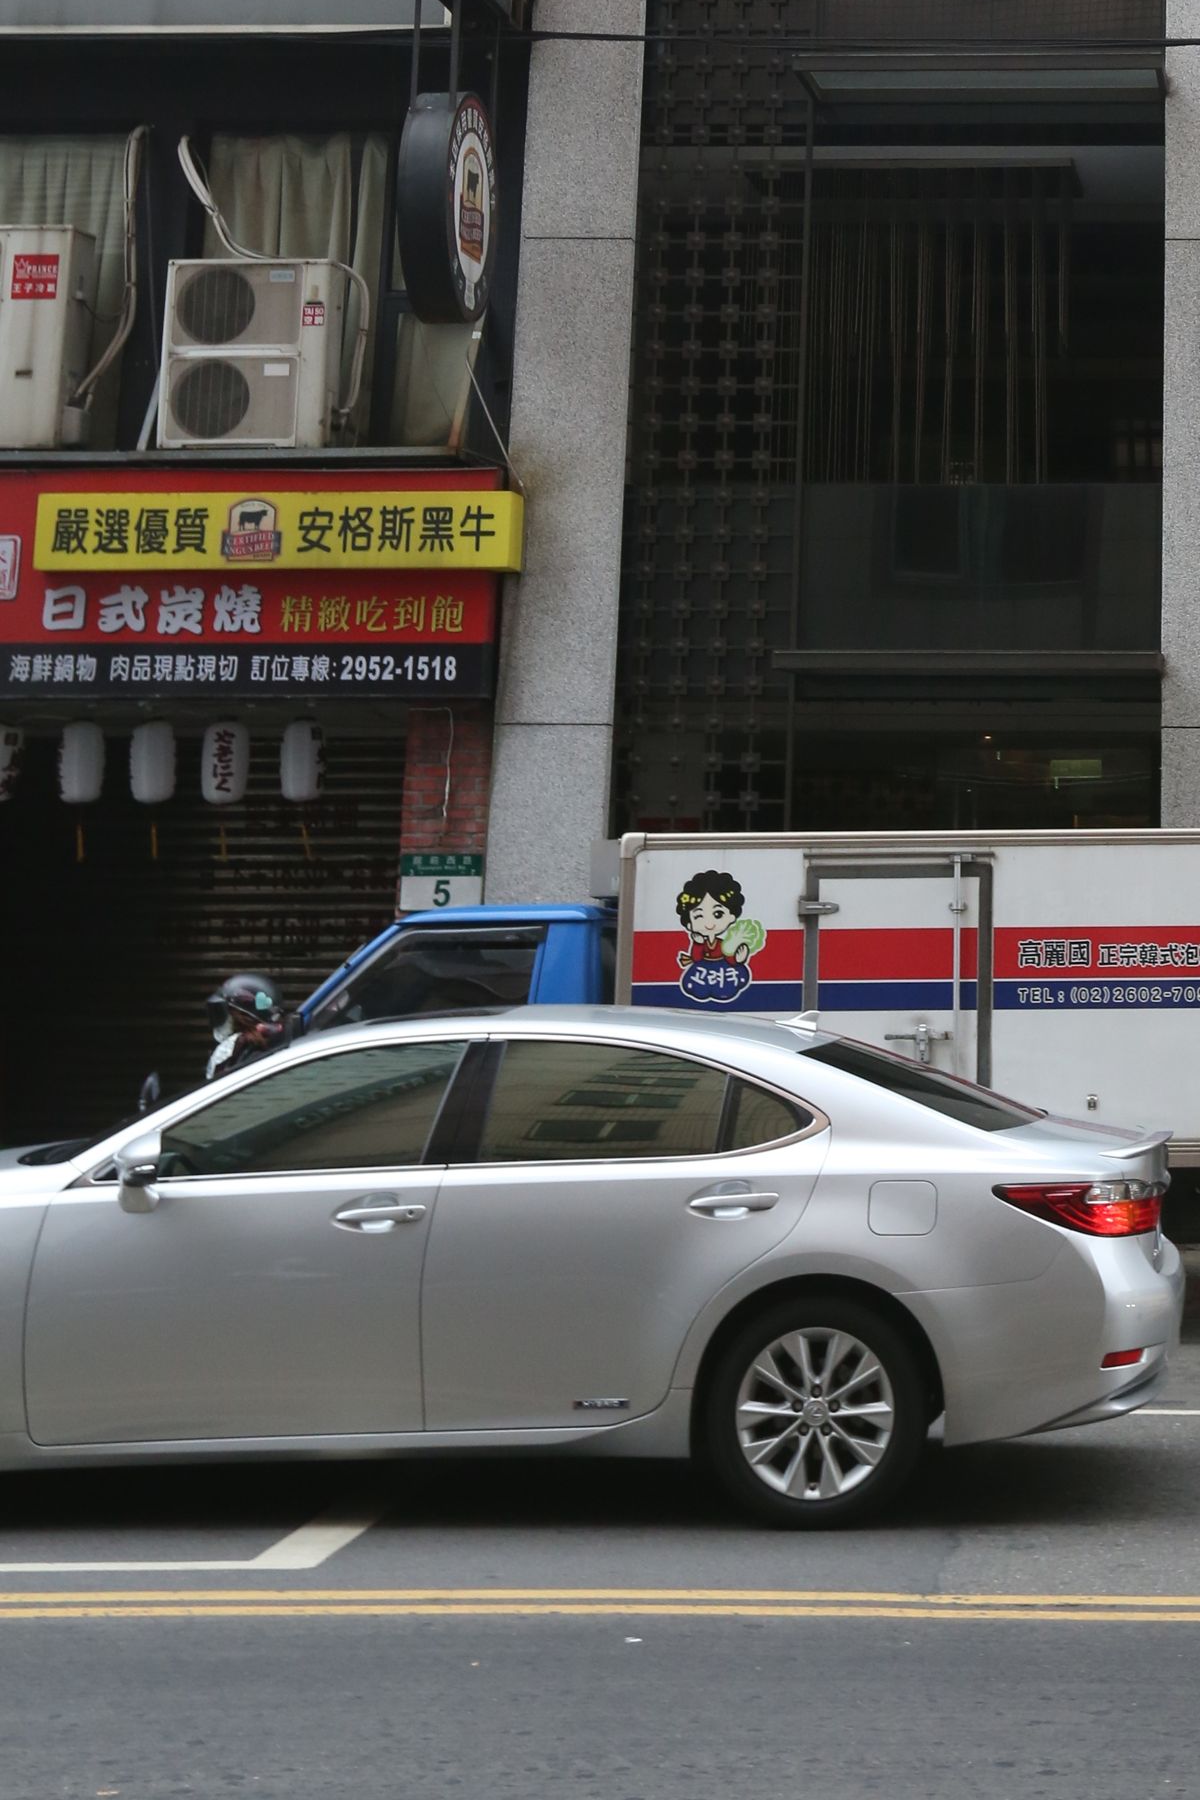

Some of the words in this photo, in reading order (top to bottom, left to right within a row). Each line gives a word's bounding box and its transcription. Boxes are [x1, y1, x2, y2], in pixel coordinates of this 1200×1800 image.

[27, 264, 57, 274] PRINCE
[51, 506, 209, 556] 嚴選優質
[296, 505, 496, 555] 安格斯黑牛
[41, 583, 262, 634] 日式炭燒
[280, 595, 465, 634] 精緻吃到飽
[9, 655, 97, 683] 海鮮鍋物
[109, 654, 239, 682] 肉品現點現切
[432, 880, 451, 907] 5
[1018, 939, 1092, 968] 高麗國
